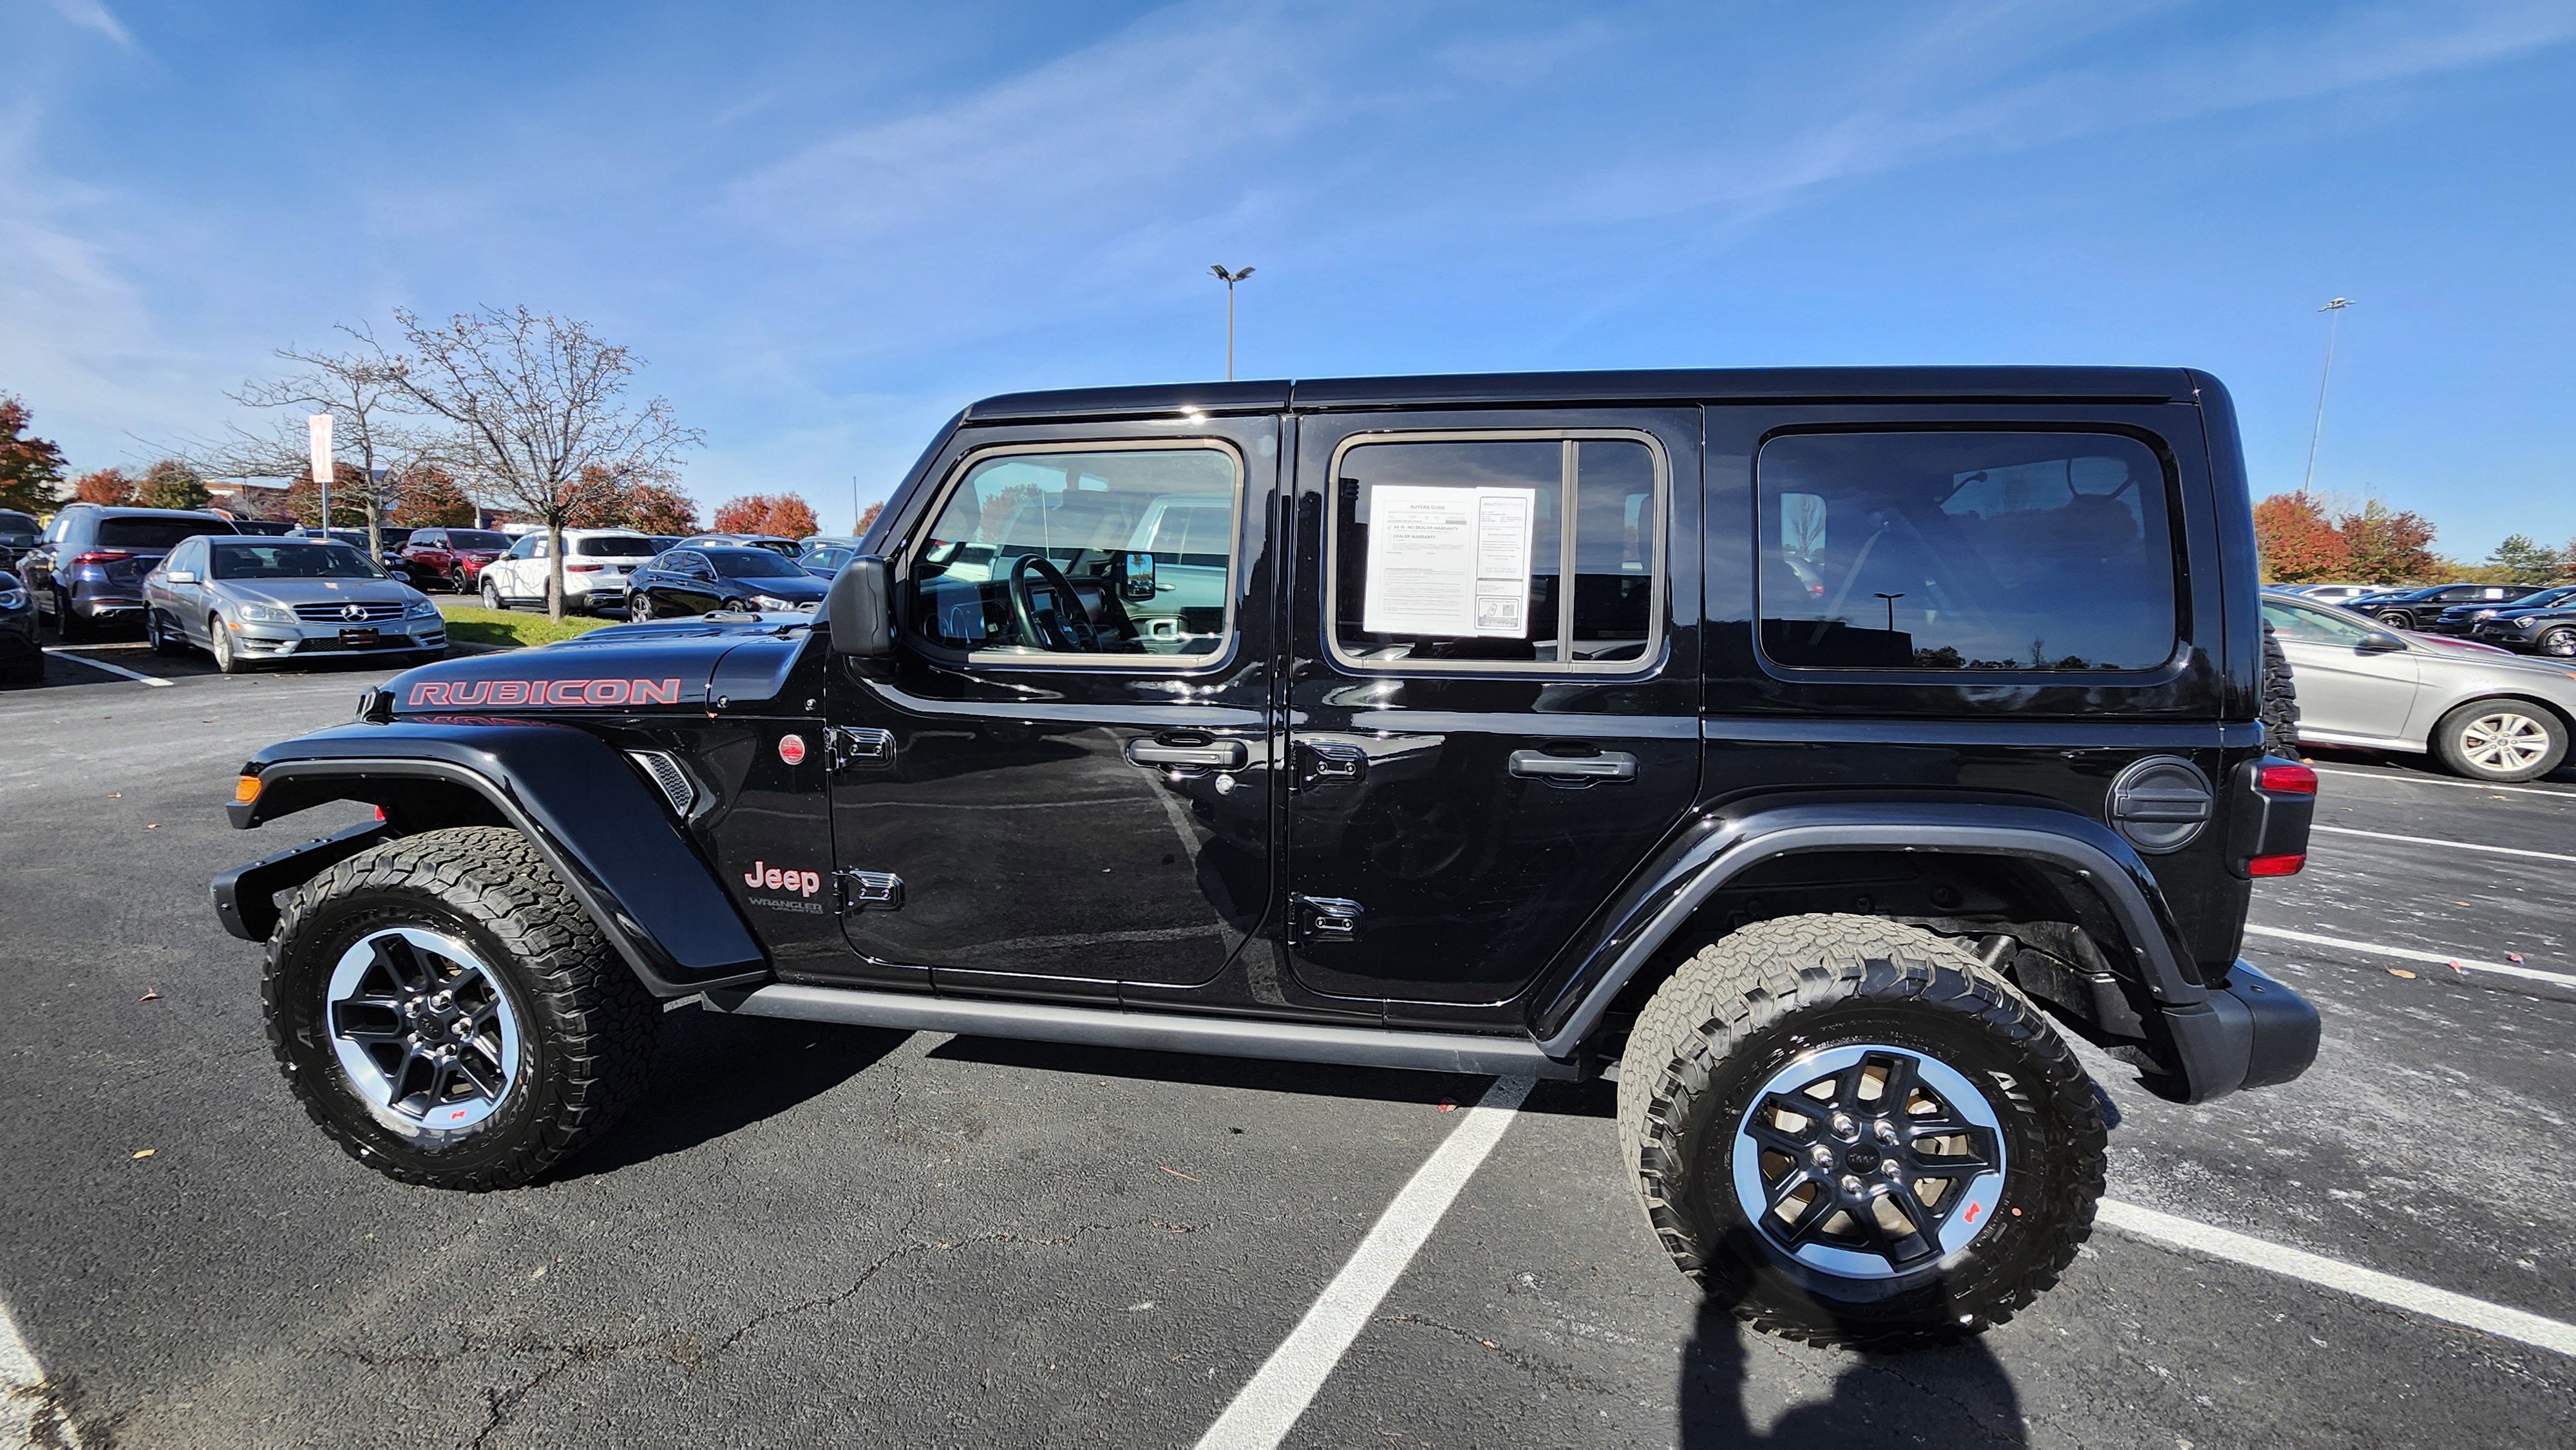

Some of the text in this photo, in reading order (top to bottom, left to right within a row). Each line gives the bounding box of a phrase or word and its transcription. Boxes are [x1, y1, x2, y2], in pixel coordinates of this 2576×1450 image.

[408, 679, 681, 706] RUBICON
[744, 861, 820, 898] Jeep
[748, 896, 822, 911] WRANGLER
[772, 906, 824, 914] UNLIMITED
